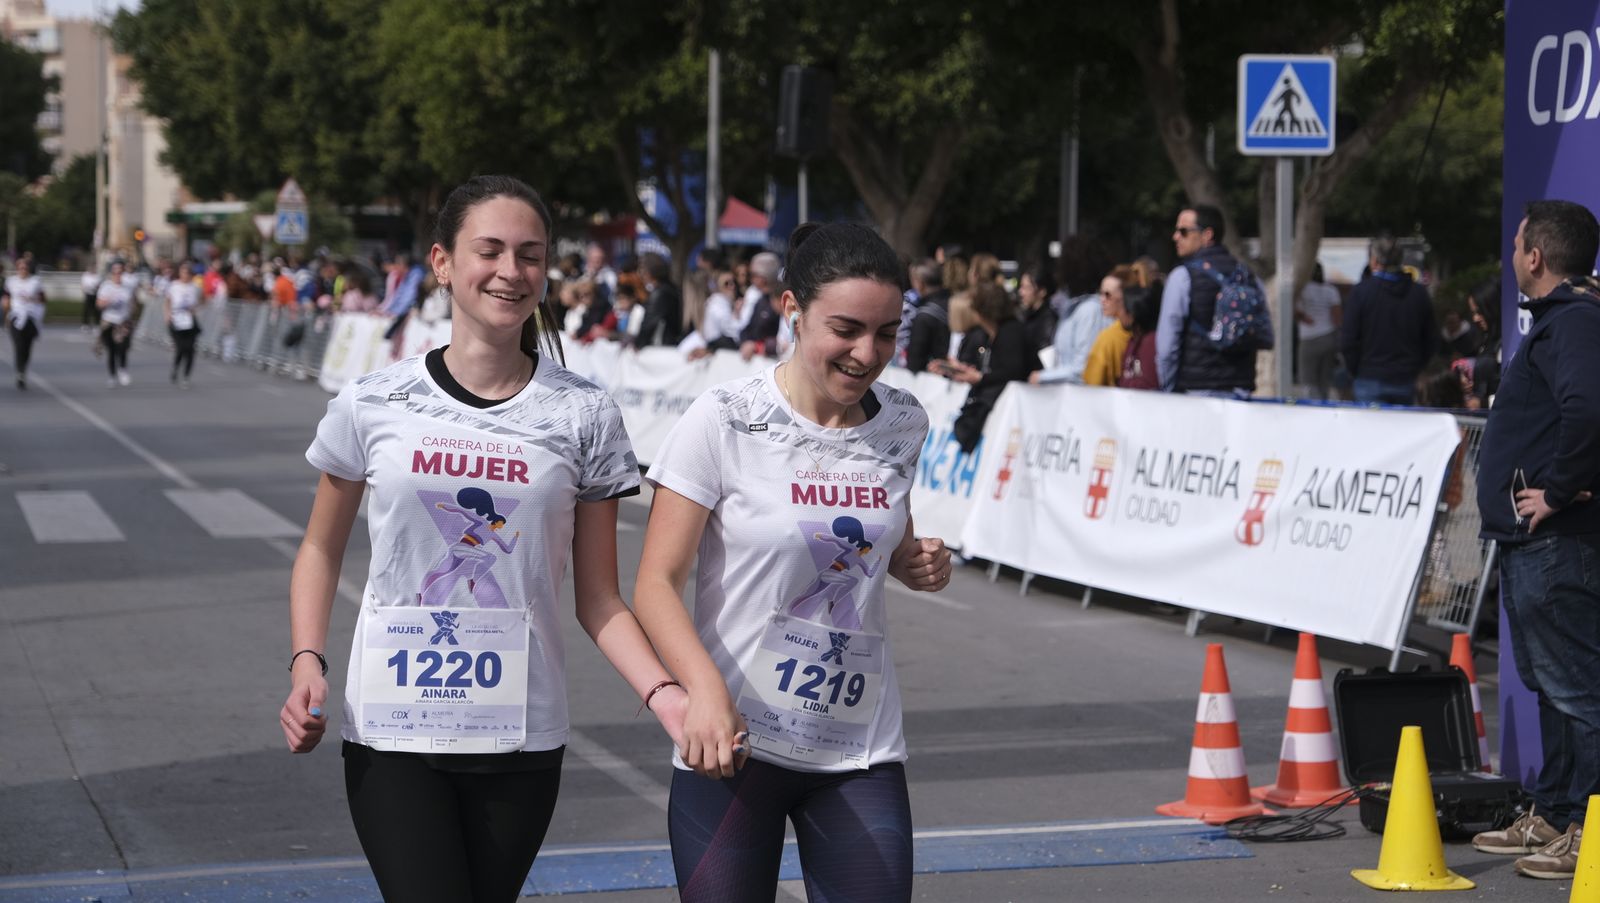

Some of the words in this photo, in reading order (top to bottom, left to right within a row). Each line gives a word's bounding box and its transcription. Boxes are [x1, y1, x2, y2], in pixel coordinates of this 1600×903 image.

[421, 436, 482, 451] CARRERA
[486, 442, 503, 453] DE
[507, 444, 523, 455] LA
[411, 450, 529, 484] MUJER
[795, 470, 848, 482] CARRERA
[851, 472, 866, 482] DE
[868, 473, 882, 483] LA
[1132, 447, 1240, 499] ALMERÍA
[791, 483, 890, 509] MUJER
[1293, 462, 1423, 520] ALMERÍA
[1125, 494, 1181, 527] CIUDAD
[1290, 516, 1352, 551] CIUDAD
[387, 626, 424, 634] MUJER
[785, 634, 819, 650] MUJER
[387, 649, 502, 688] 1220
[421, 689, 467, 698] AINARA
[774, 657, 865, 708] 1219
[391, 710, 410, 719] CDX
[763, 711, 781, 721] CDX
[802, 700, 829, 714] LIDIA
